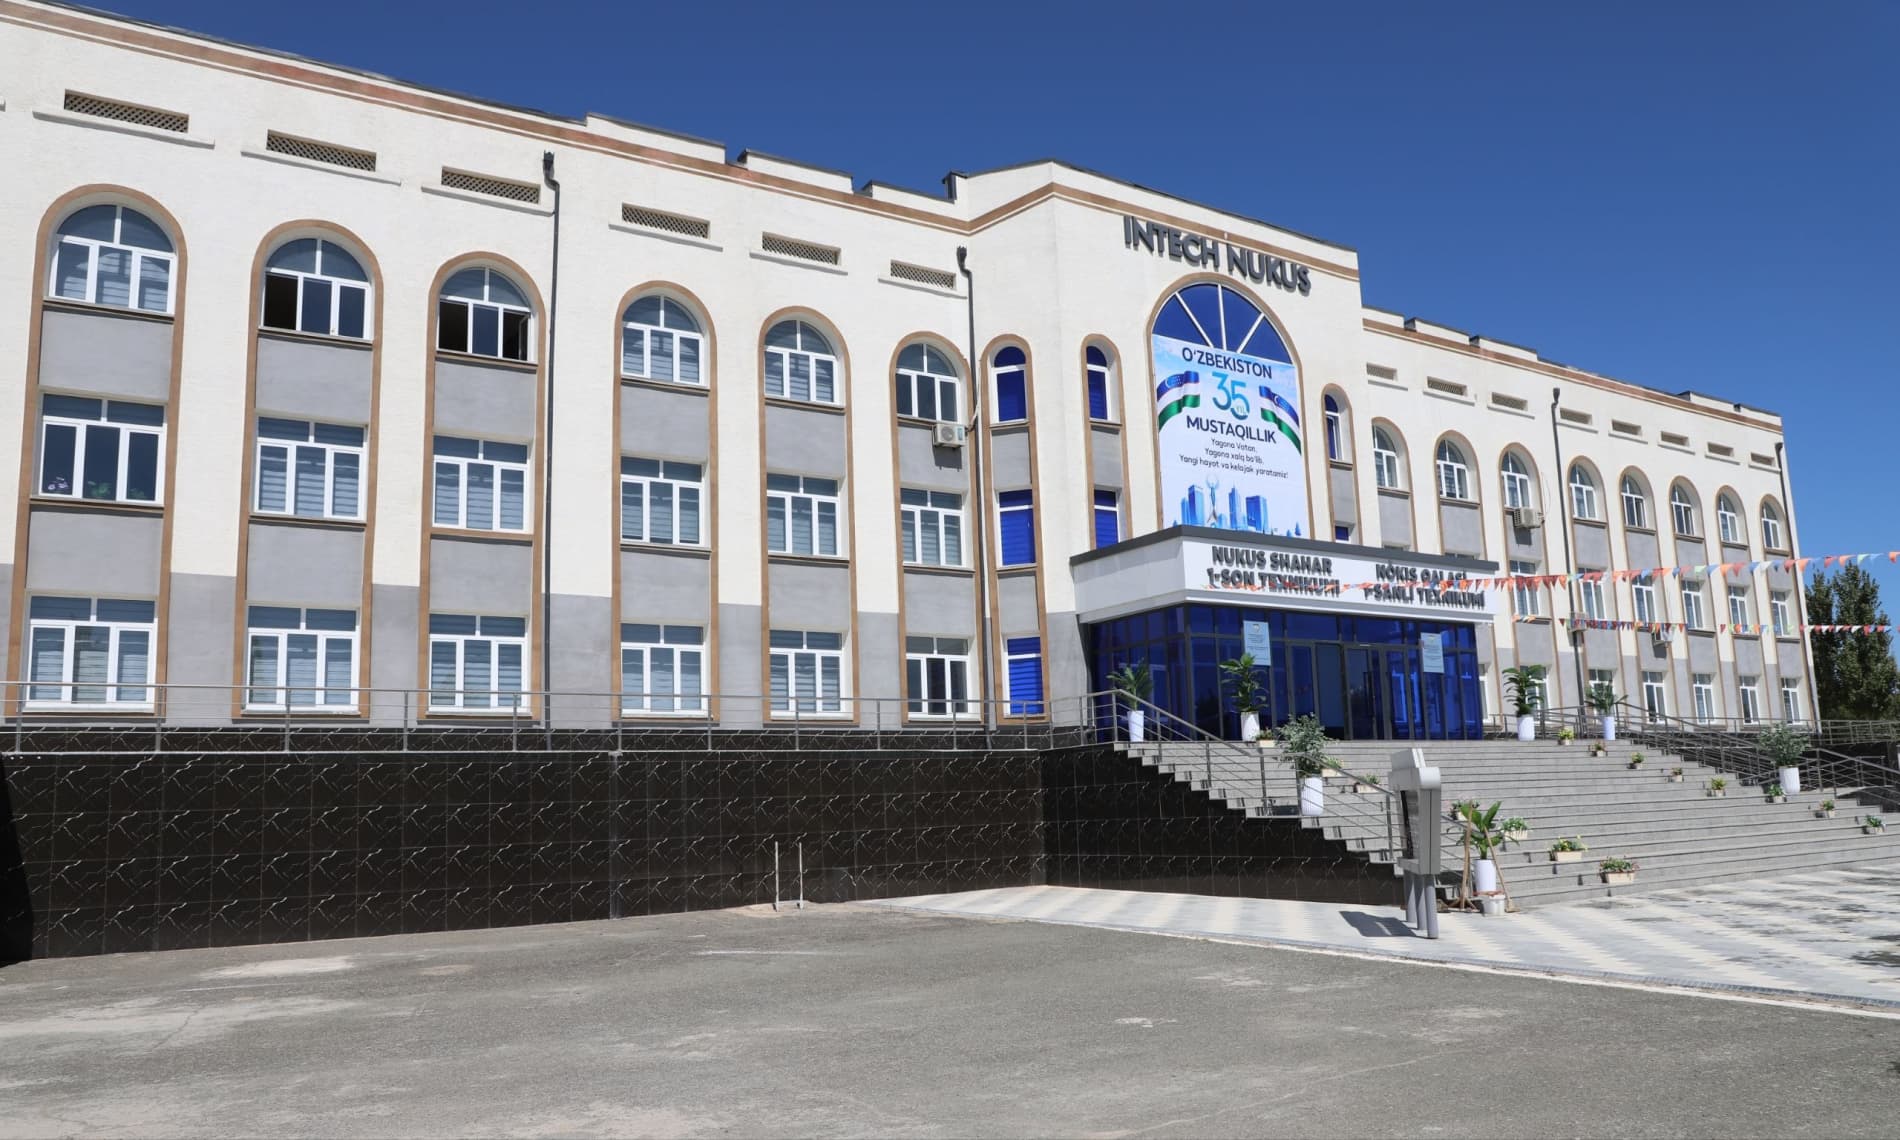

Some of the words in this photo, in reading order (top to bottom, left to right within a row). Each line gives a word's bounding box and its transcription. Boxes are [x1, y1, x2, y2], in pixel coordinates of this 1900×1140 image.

[1124, 215, 1220, 271] INTECH
[1227, 244, 1312, 296] NUKUS
[1211, 371, 1250, 420] 35
[1186, 415, 1277, 444] MUSTAQILLIK
[1205, 448, 1231, 459] Yagona
[1231, 451, 1245, 462] xalq
[1211, 438, 1236, 449] Yagona
[1179, 454, 1199, 466] Yangi
[1199, 456, 1220, 468] hayot
[1221, 461, 1230, 469] va
[1230, 461, 1255, 474] kelajak
[1211, 545, 1267, 571] NUKUS
[1269, 552, 1333, 576] SHAHAR
[1206, 567, 1256, 589] 1-SON
